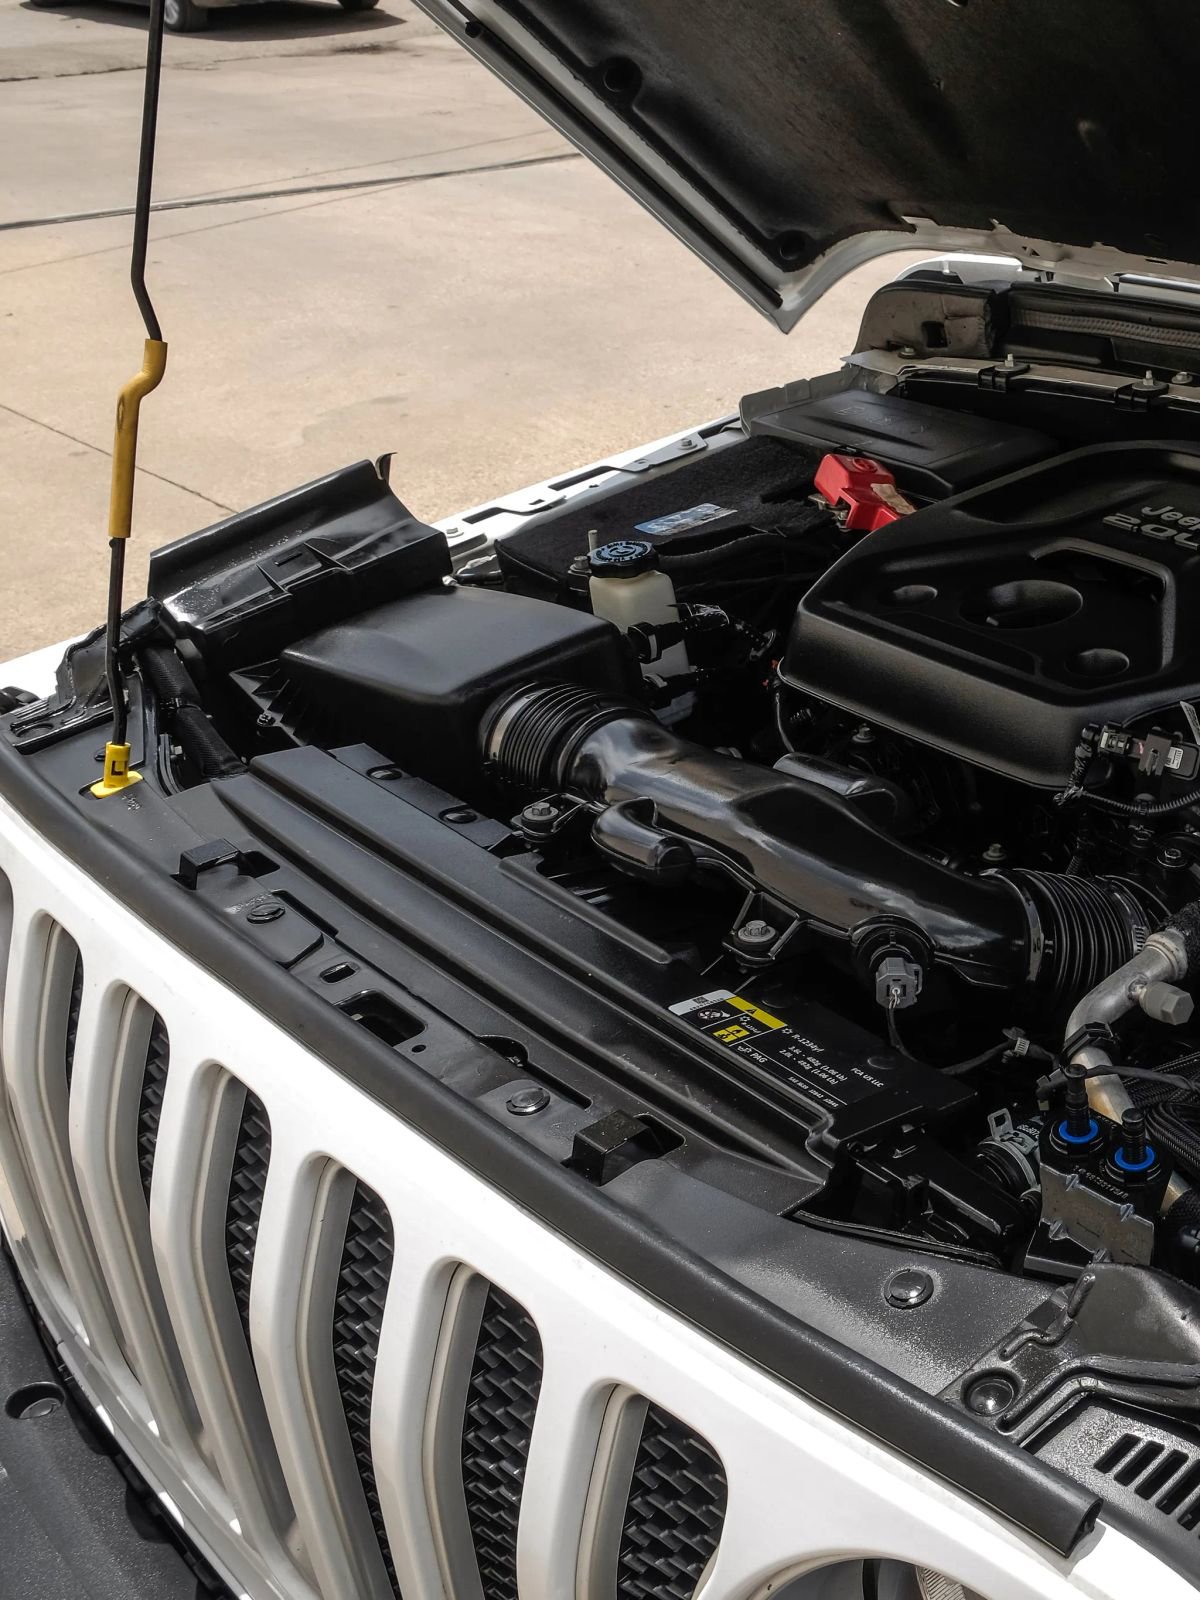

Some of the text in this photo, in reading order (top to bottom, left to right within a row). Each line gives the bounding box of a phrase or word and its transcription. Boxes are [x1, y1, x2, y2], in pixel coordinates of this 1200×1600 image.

[1103, 513, 1200, 550] 2.0L
[791, 1033, 825, 1053] R-1234yf
[749, 1052, 769, 1063] PAG
